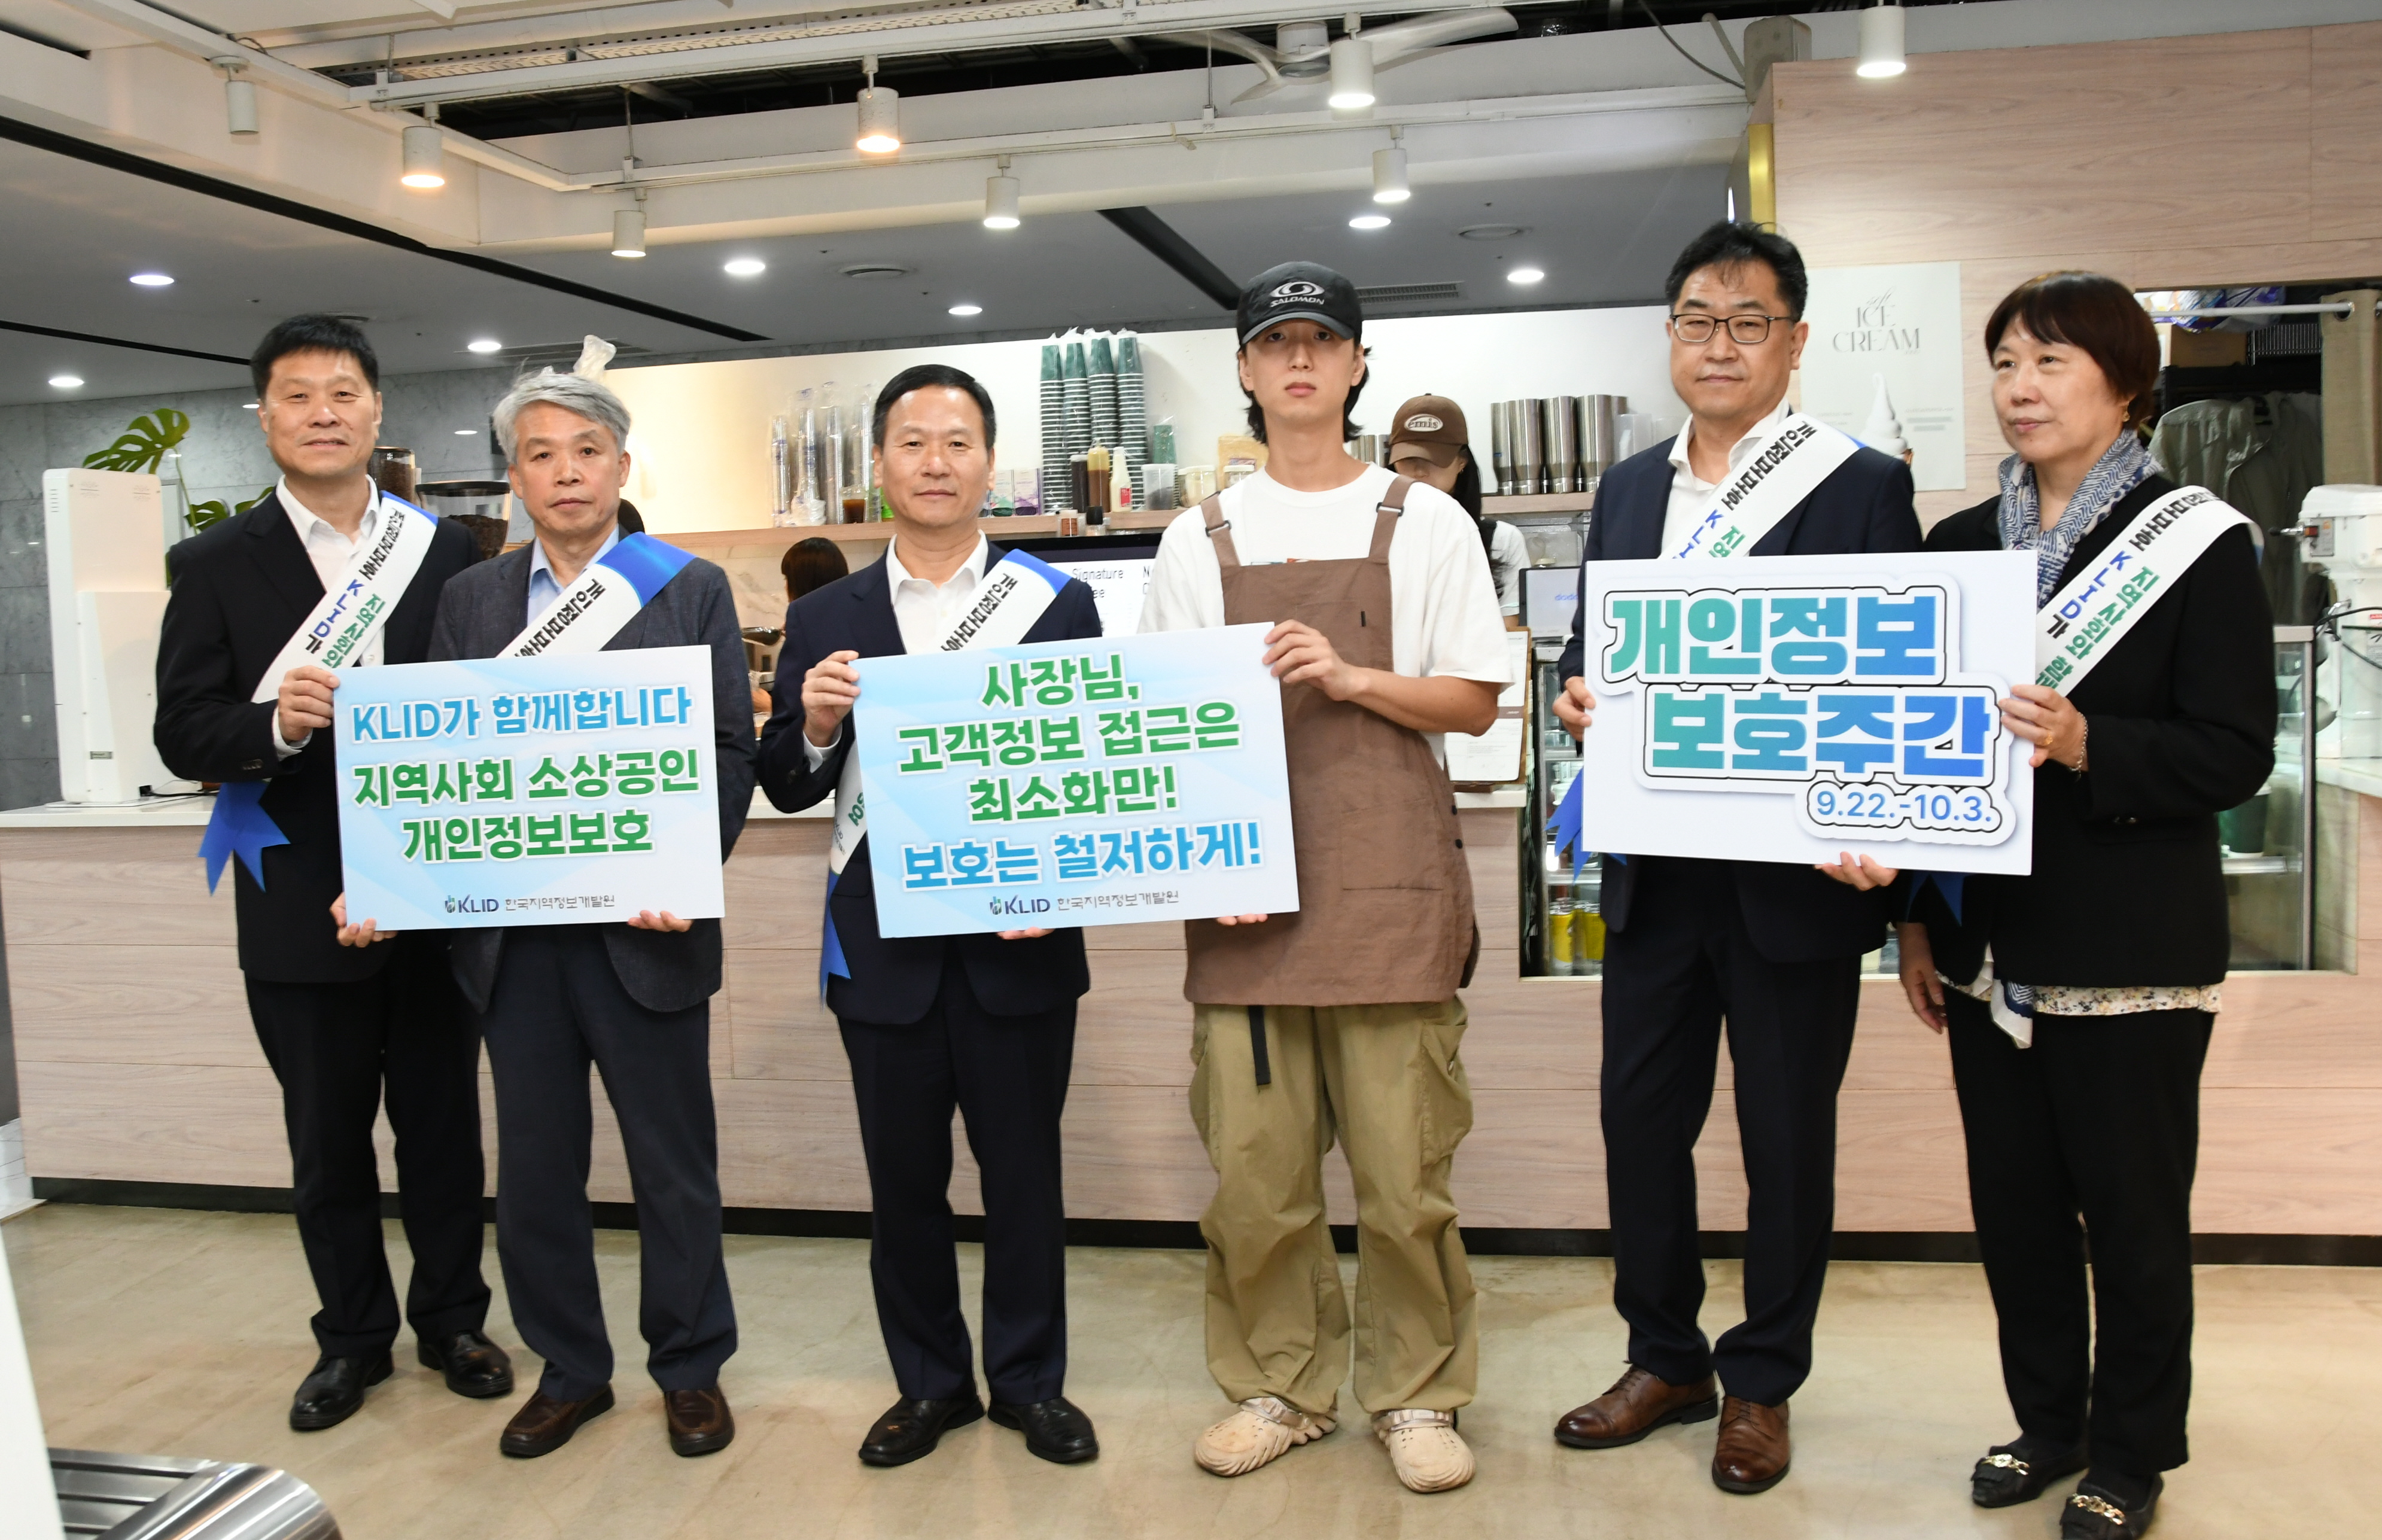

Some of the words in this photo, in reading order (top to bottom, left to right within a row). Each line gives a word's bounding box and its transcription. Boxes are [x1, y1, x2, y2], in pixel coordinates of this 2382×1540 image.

[1270, 296, 1325, 308] SALOMON
[1857, 305, 1896, 327] ICE
[1832, 328, 1920, 352] CREAM
[1721, 421, 1818, 511] 개인정보보호
[358, 507, 406, 581] 개인정보보호
[1072, 568, 1124, 582] Signature
[305, 579, 364, 655] KLID가
[941, 573, 1019, 652] 개인정보보호
[2047, 550, 2133, 640] KLID가
[2065, 566, 2161, 660] 지역사회와
[321, 594, 387, 669] 지역사회와
[1610, 596, 1937, 676] 개인정보
[983, 655, 1139, 707] 사장님,
[354, 698, 480, 741] KLID가
[492, 686, 692, 734] 함께합니다
[899, 716, 1084, 773] 고객정보
[1098, 702, 1239, 757] 접근은
[1652, 692, 1991, 777] 보호주간
[354, 759, 514, 806] 지역사회
[529, 749, 698, 799] 소상공인
[970, 766, 1176, 821] 최소화만!
[403, 809, 652, 862] 개인정보보호
[905, 840, 1040, 889] 보호는
[1054, 822, 1261, 879] 철저하게!
[458, 894, 499, 913] KLID
[505, 895, 616, 911] 한국지역정보개발원
[1005, 895, 1051, 914] KLID
[1057, 891, 1179, 911] 한국지역정보개발원
